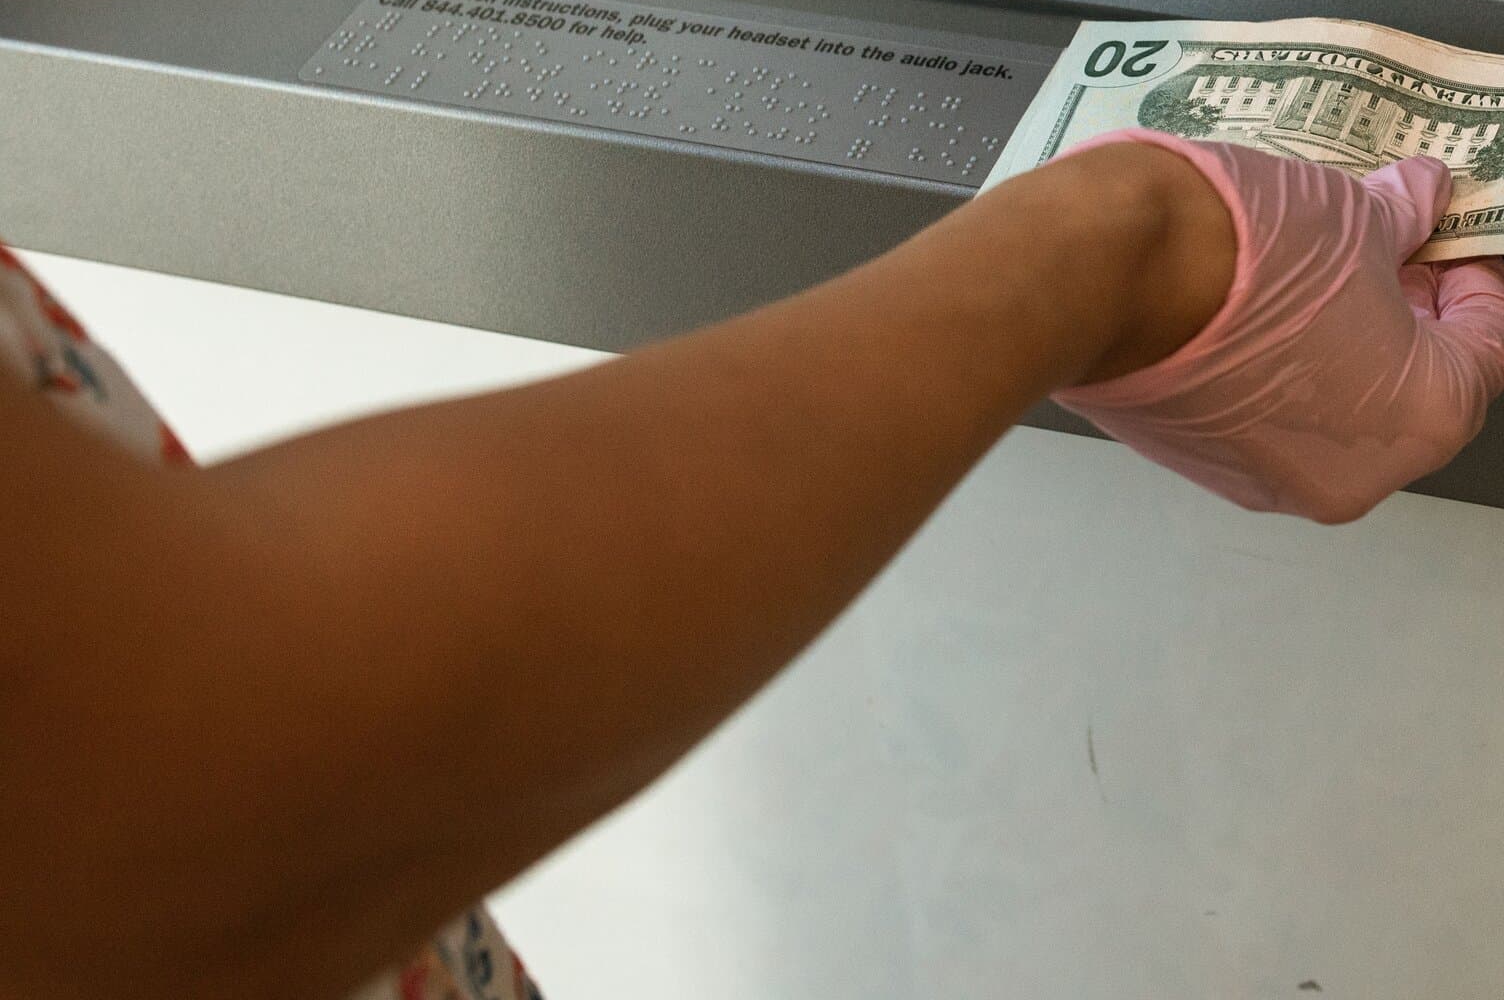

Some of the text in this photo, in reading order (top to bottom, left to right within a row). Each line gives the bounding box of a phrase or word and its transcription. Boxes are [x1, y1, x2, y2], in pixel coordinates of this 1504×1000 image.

[569, 21, 599, 36] for
[600, 25, 648, 45] help.
[629, 13, 678, 32] plug
[675, 21, 725, 37] your
[727, 26, 811, 51] headset
[815, 38, 855, 56] into
[861, 45, 895, 62] the
[900, 52, 958, 71] audio
[959, 60, 1013, 80] jack.
[1084, 40, 1169, 78] 20
[1213, 48, 1369, 72] DOLLARS
